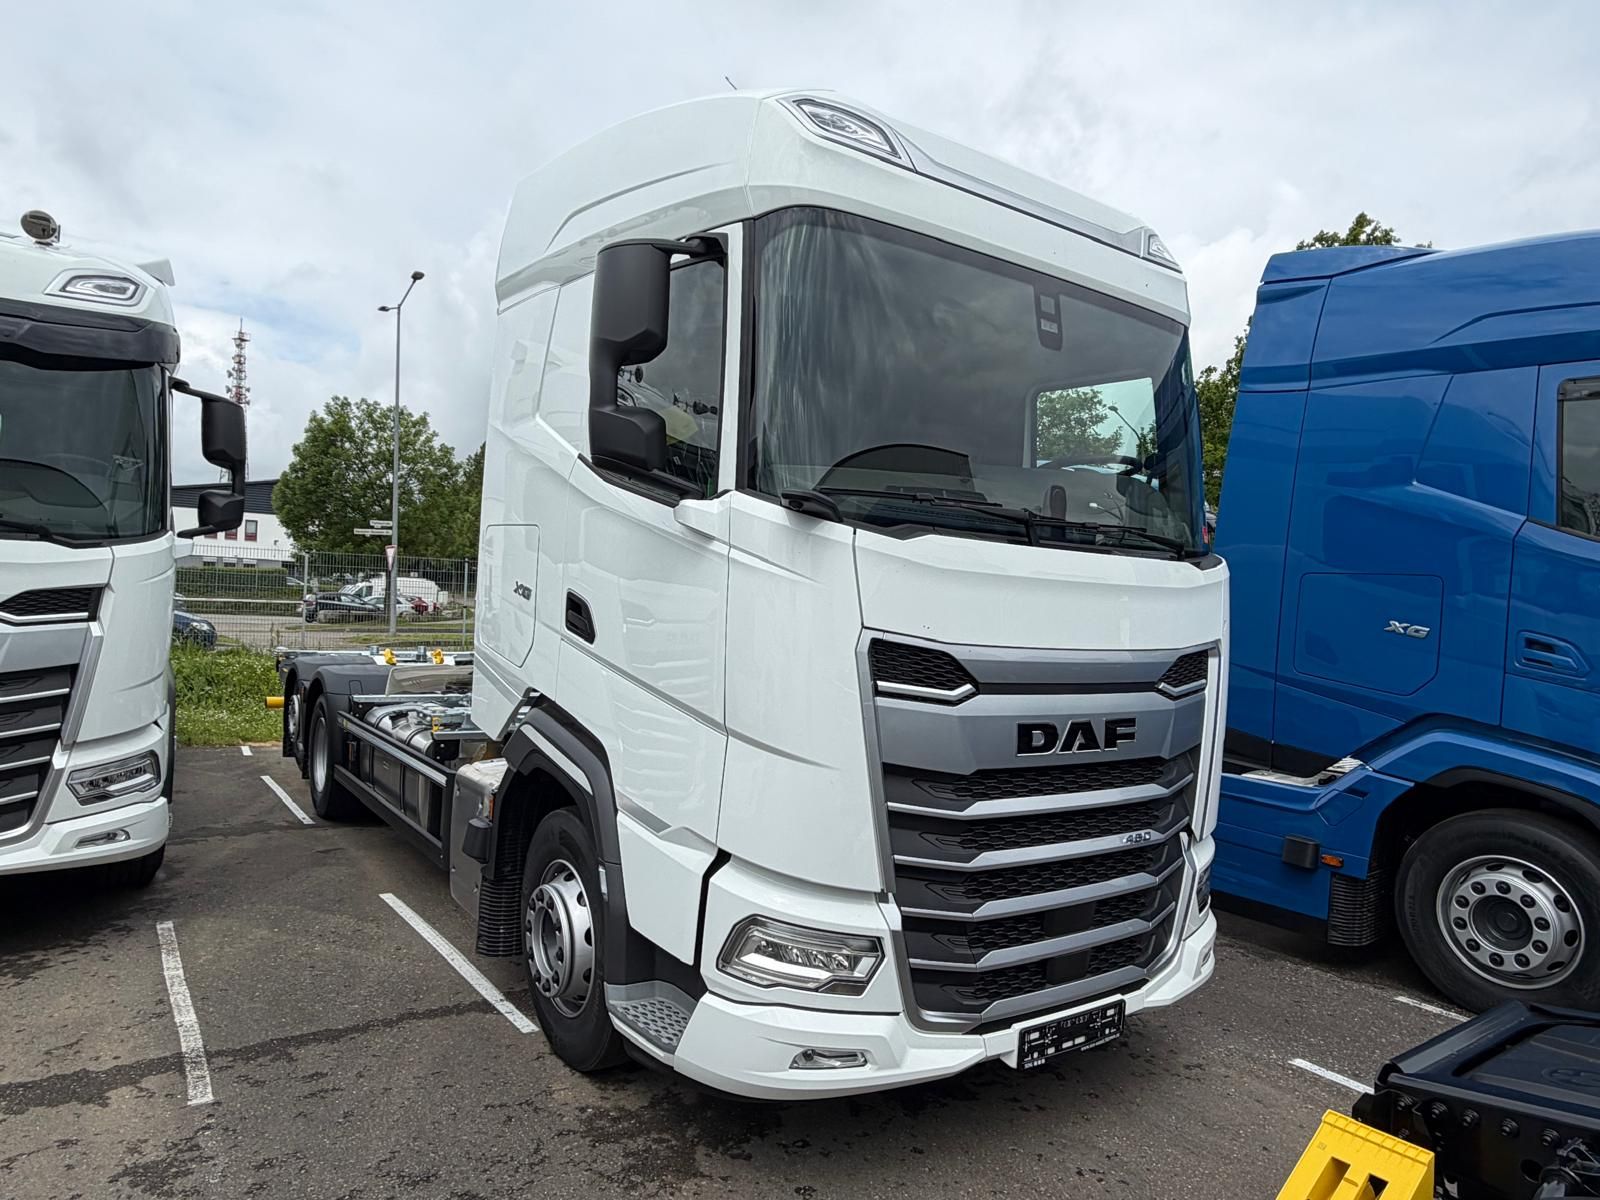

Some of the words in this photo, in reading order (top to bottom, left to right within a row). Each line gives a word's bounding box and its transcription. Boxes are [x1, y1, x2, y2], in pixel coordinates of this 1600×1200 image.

[1384, 620, 1430, 638] XG
[1016, 717, 1137, 756] DAF
[1123, 831, 1151, 844] 480
